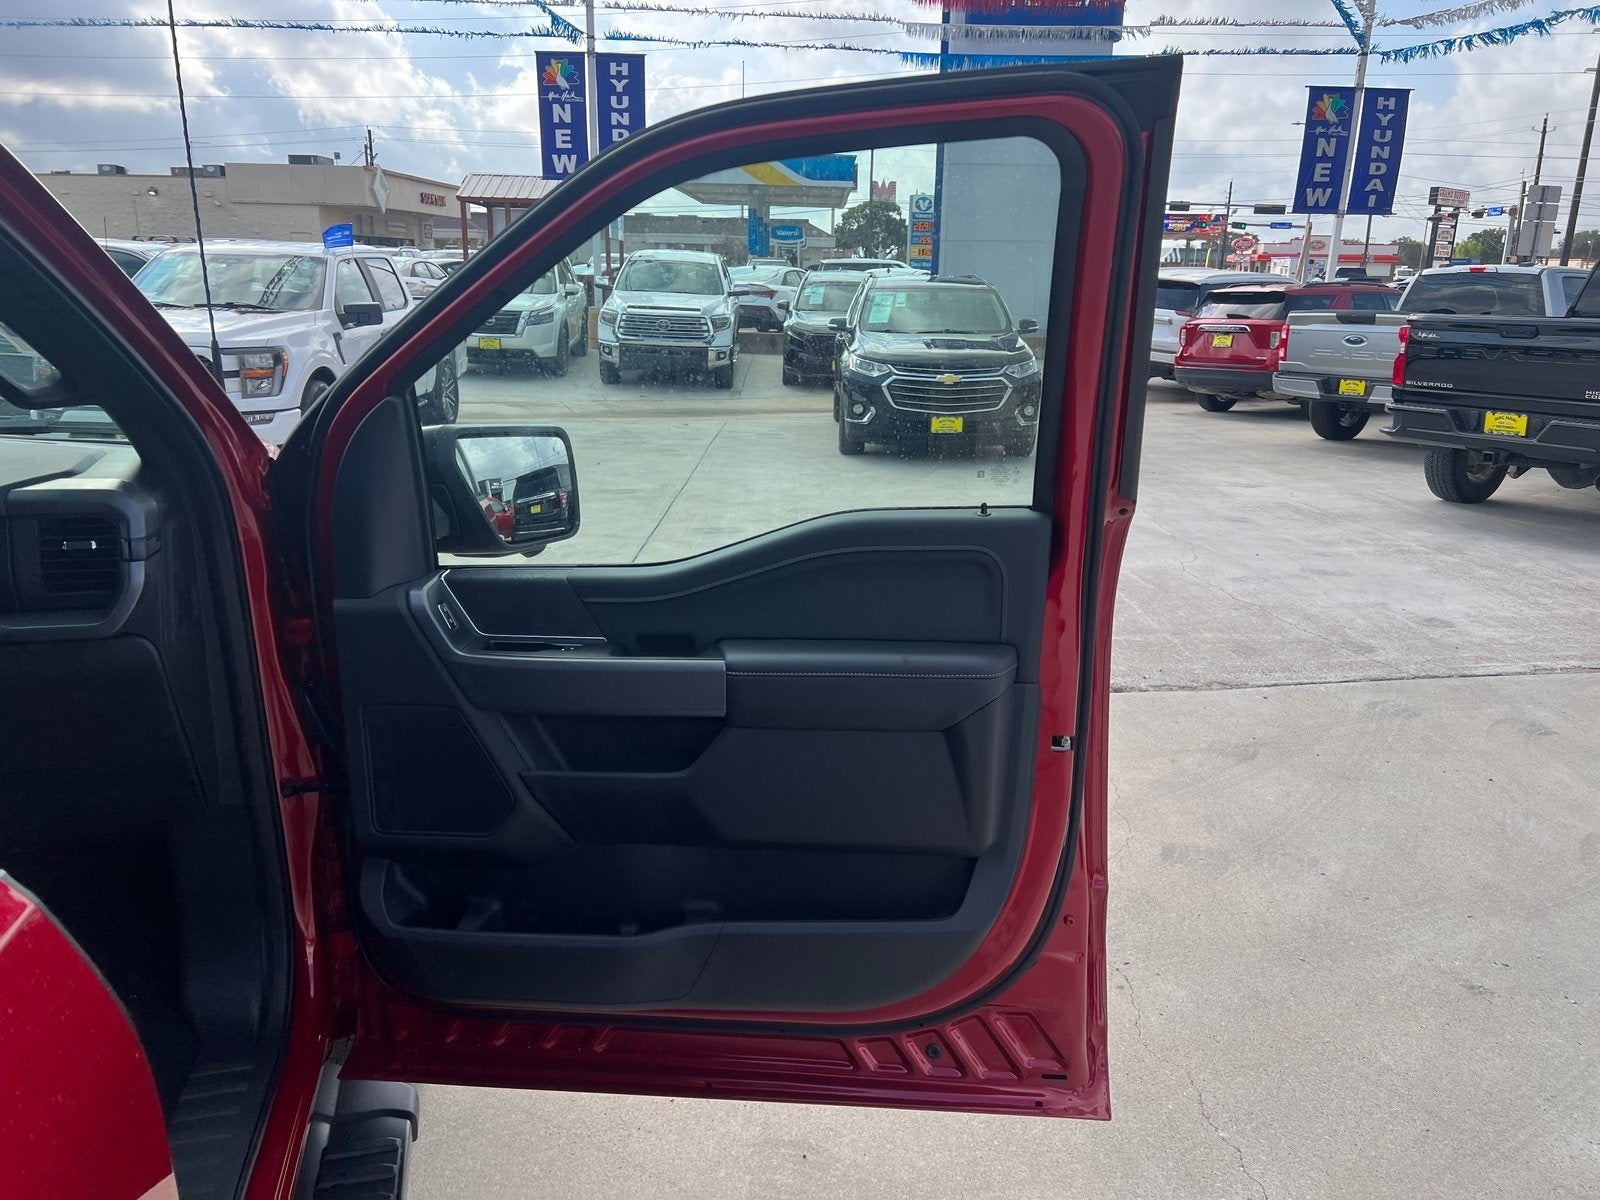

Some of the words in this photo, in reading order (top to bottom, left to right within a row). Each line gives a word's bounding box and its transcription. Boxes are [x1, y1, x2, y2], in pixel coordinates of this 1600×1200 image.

[552, 103, 577, 174] NEW
[1306, 138, 1337, 207] NEW
[1364, 97, 1396, 208] HYUNDAI
[776, 229, 798, 237] Valero
[1406, 380, 1453, 388] SILVERADO
